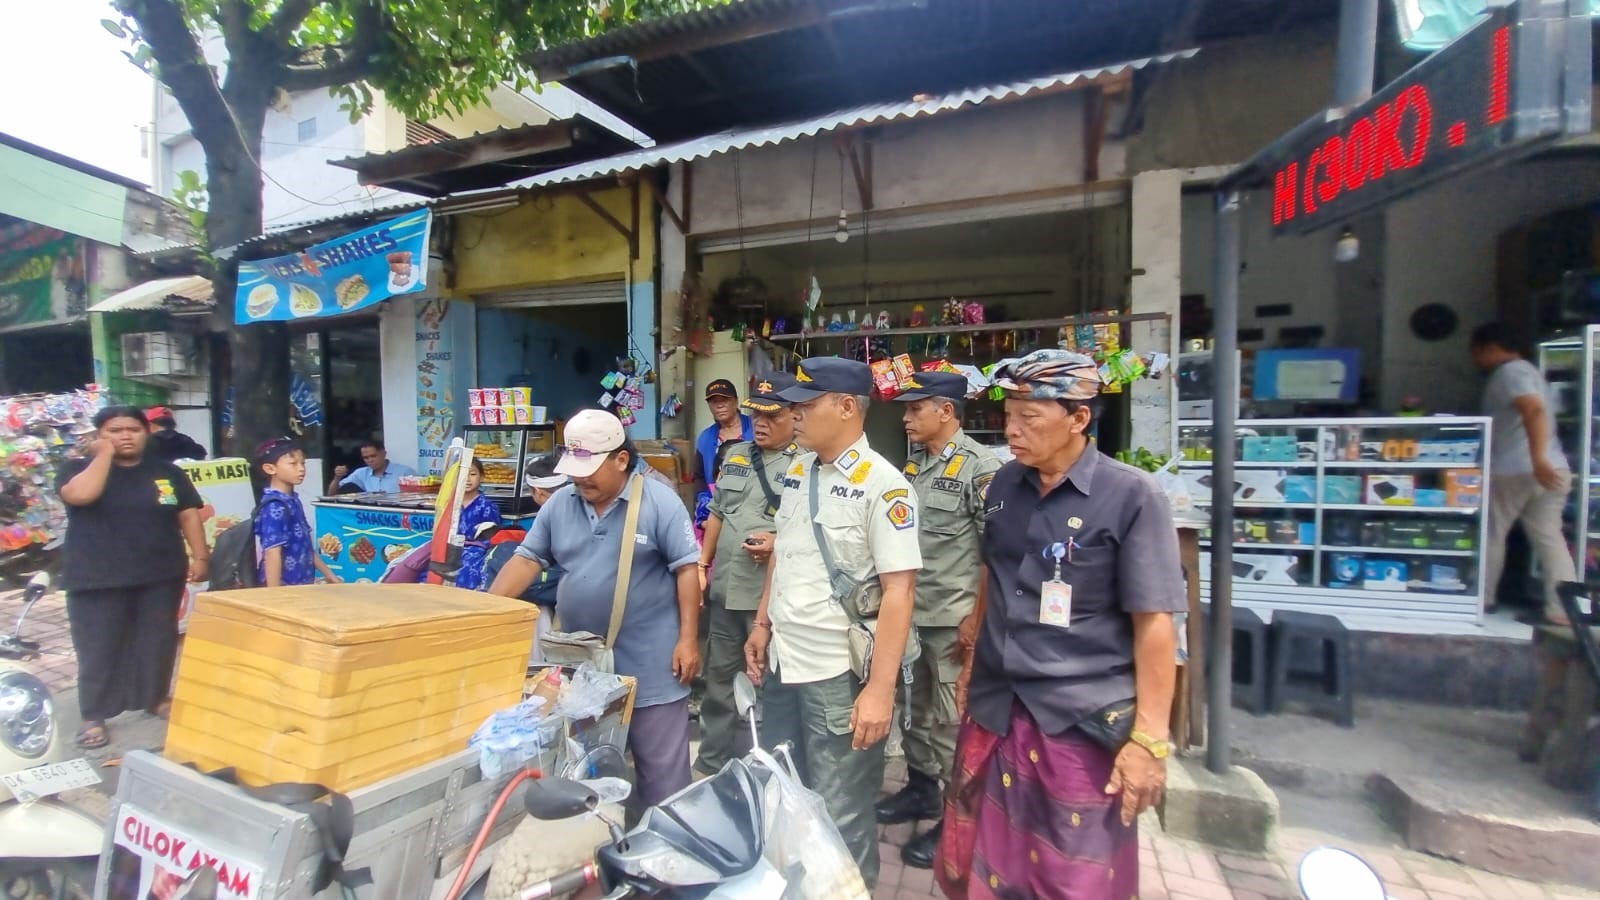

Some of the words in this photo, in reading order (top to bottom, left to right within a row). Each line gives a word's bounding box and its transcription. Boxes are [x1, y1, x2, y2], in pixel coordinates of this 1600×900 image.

[316, 228, 398, 271] SHAKES
[416, 332, 440, 341] SNACKS
[426, 352, 452, 361] SHAKES
[419, 449, 444, 458] SNACKS
[216, 464, 249, 481] NASI
[830, 485, 848, 498] POL
[850, 489, 865, 500] PP
[934, 480, 948, 489] POL
[948, 482, 961, 491] PP
[355, 511, 401, 528] SNACKS
[123, 816, 186, 868] CILOK
[187, 848, 251, 897] AYAM
